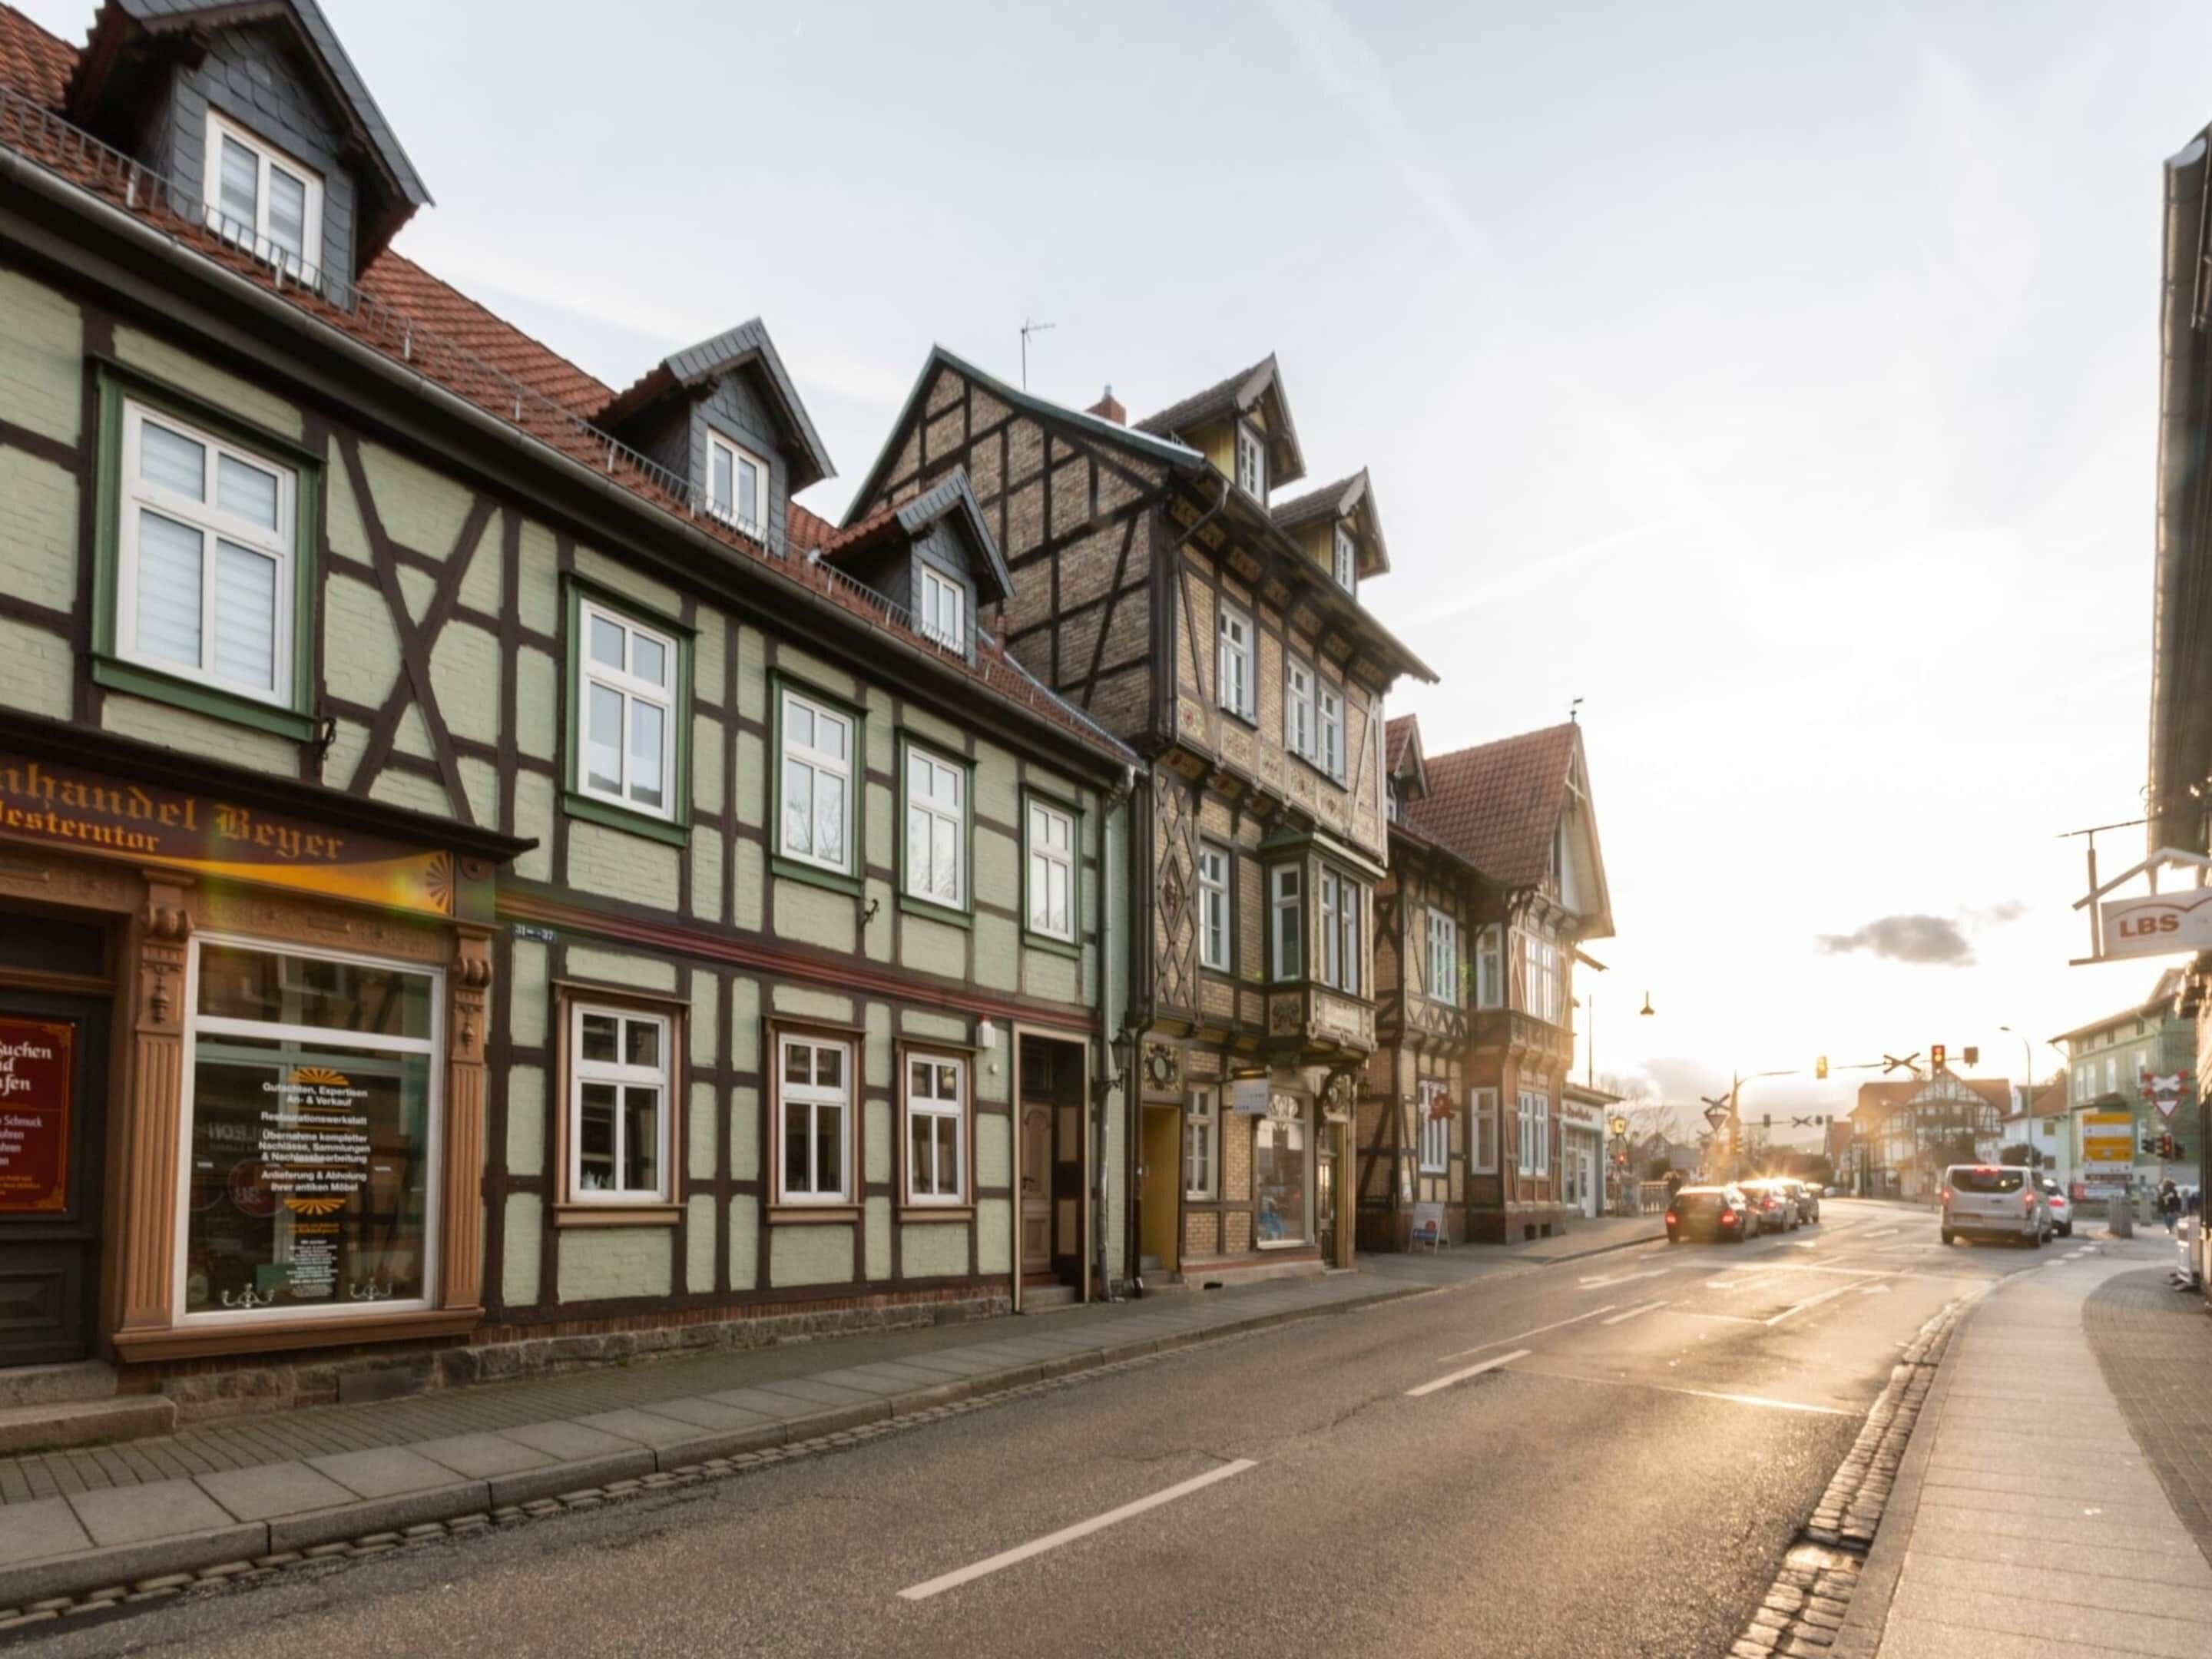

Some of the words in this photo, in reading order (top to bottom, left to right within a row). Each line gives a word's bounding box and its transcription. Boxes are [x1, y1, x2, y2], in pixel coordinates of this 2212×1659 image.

[0, 799, 160, 853] esterntor
[214, 803, 344, 860] Beyer
[2120, 914, 2180, 938] LBS
[316, 1096, 352, 1107] Verkauf
